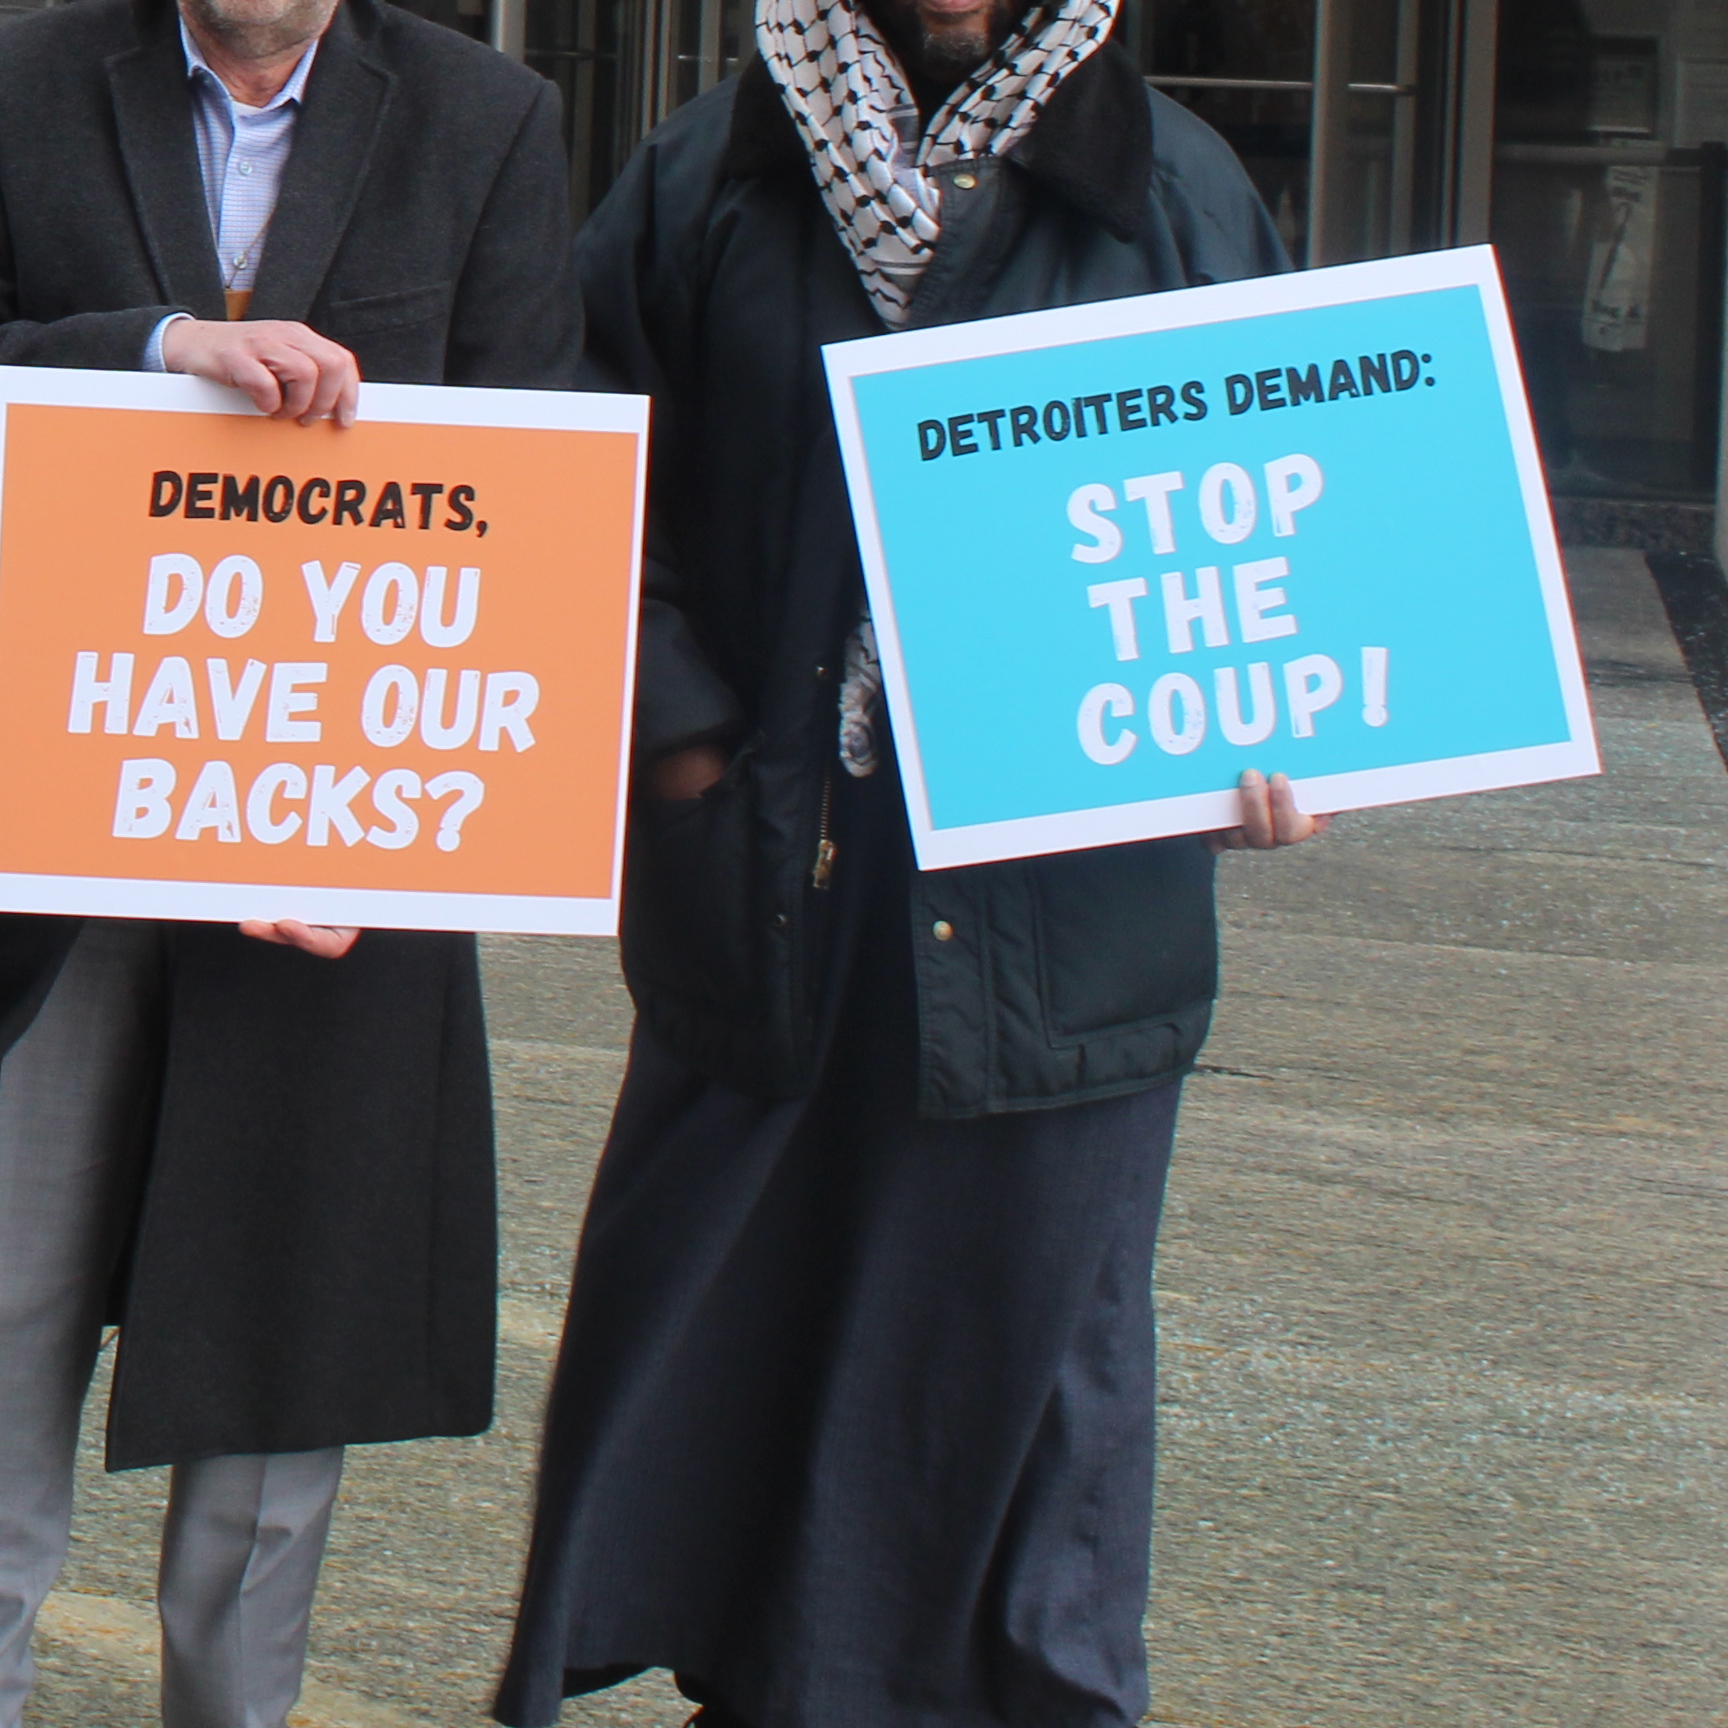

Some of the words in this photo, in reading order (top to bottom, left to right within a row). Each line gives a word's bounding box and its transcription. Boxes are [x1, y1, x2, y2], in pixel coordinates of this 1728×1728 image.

[917, 380, 1207, 461] DETROITERS
[1225, 349, 1436, 416] DEMAND:
[150, 470, 488, 537] DEMOCRATS,
[1066, 453, 1324, 564] STOP
[143, 553, 264, 638] DO
[301, 560, 481, 648] YOU
[1087, 556, 1298, 662] THE
[67, 651, 328, 742] HAVE
[360, 664, 540, 752] OUR
[1076, 646, 1389, 765] COUP!
[111, 758, 485, 852] BACKS?
